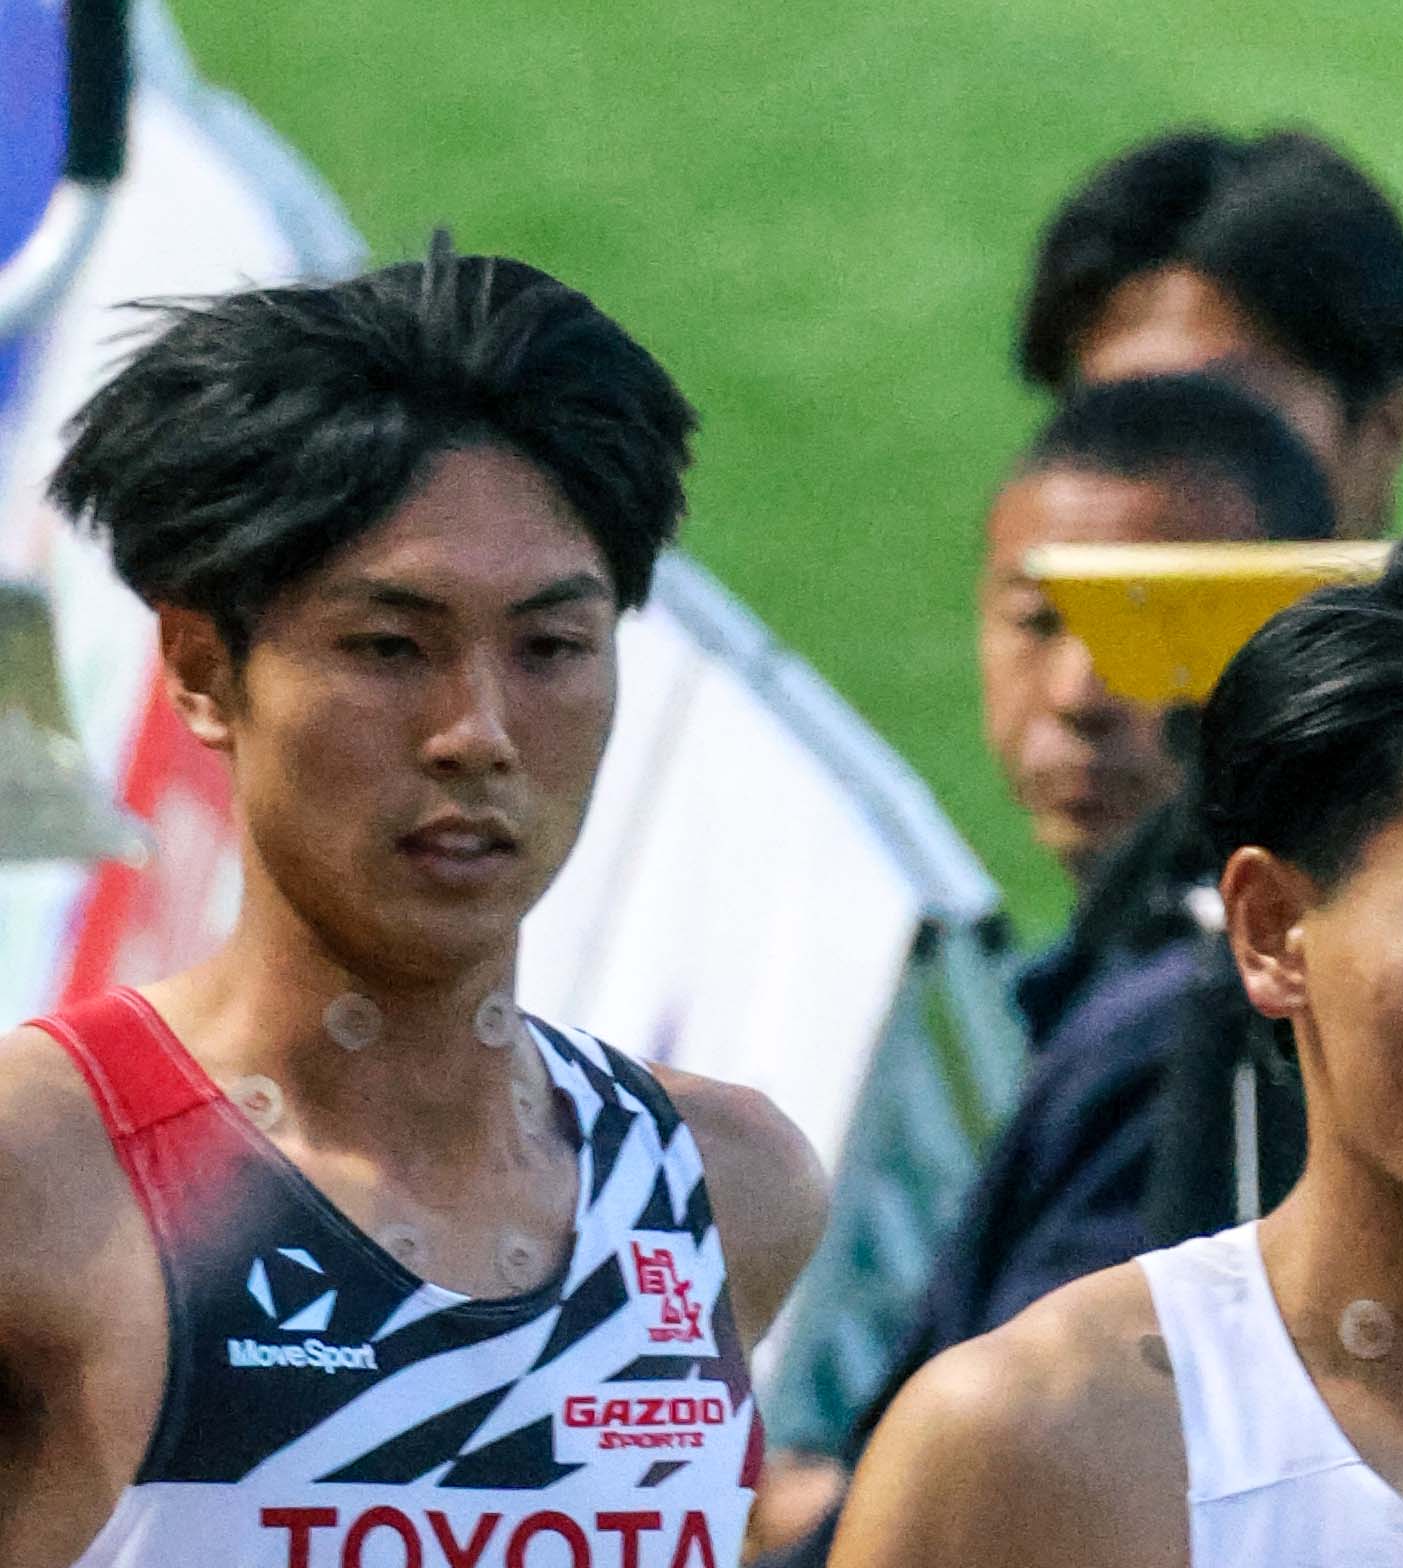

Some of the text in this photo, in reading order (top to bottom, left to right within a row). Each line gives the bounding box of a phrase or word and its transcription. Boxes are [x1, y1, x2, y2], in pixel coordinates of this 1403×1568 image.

[227, 1338, 379, 1374] MoveSport
[564, 1396, 724, 1427] GAZOO
[599, 1432, 703, 1449] SPORTS
